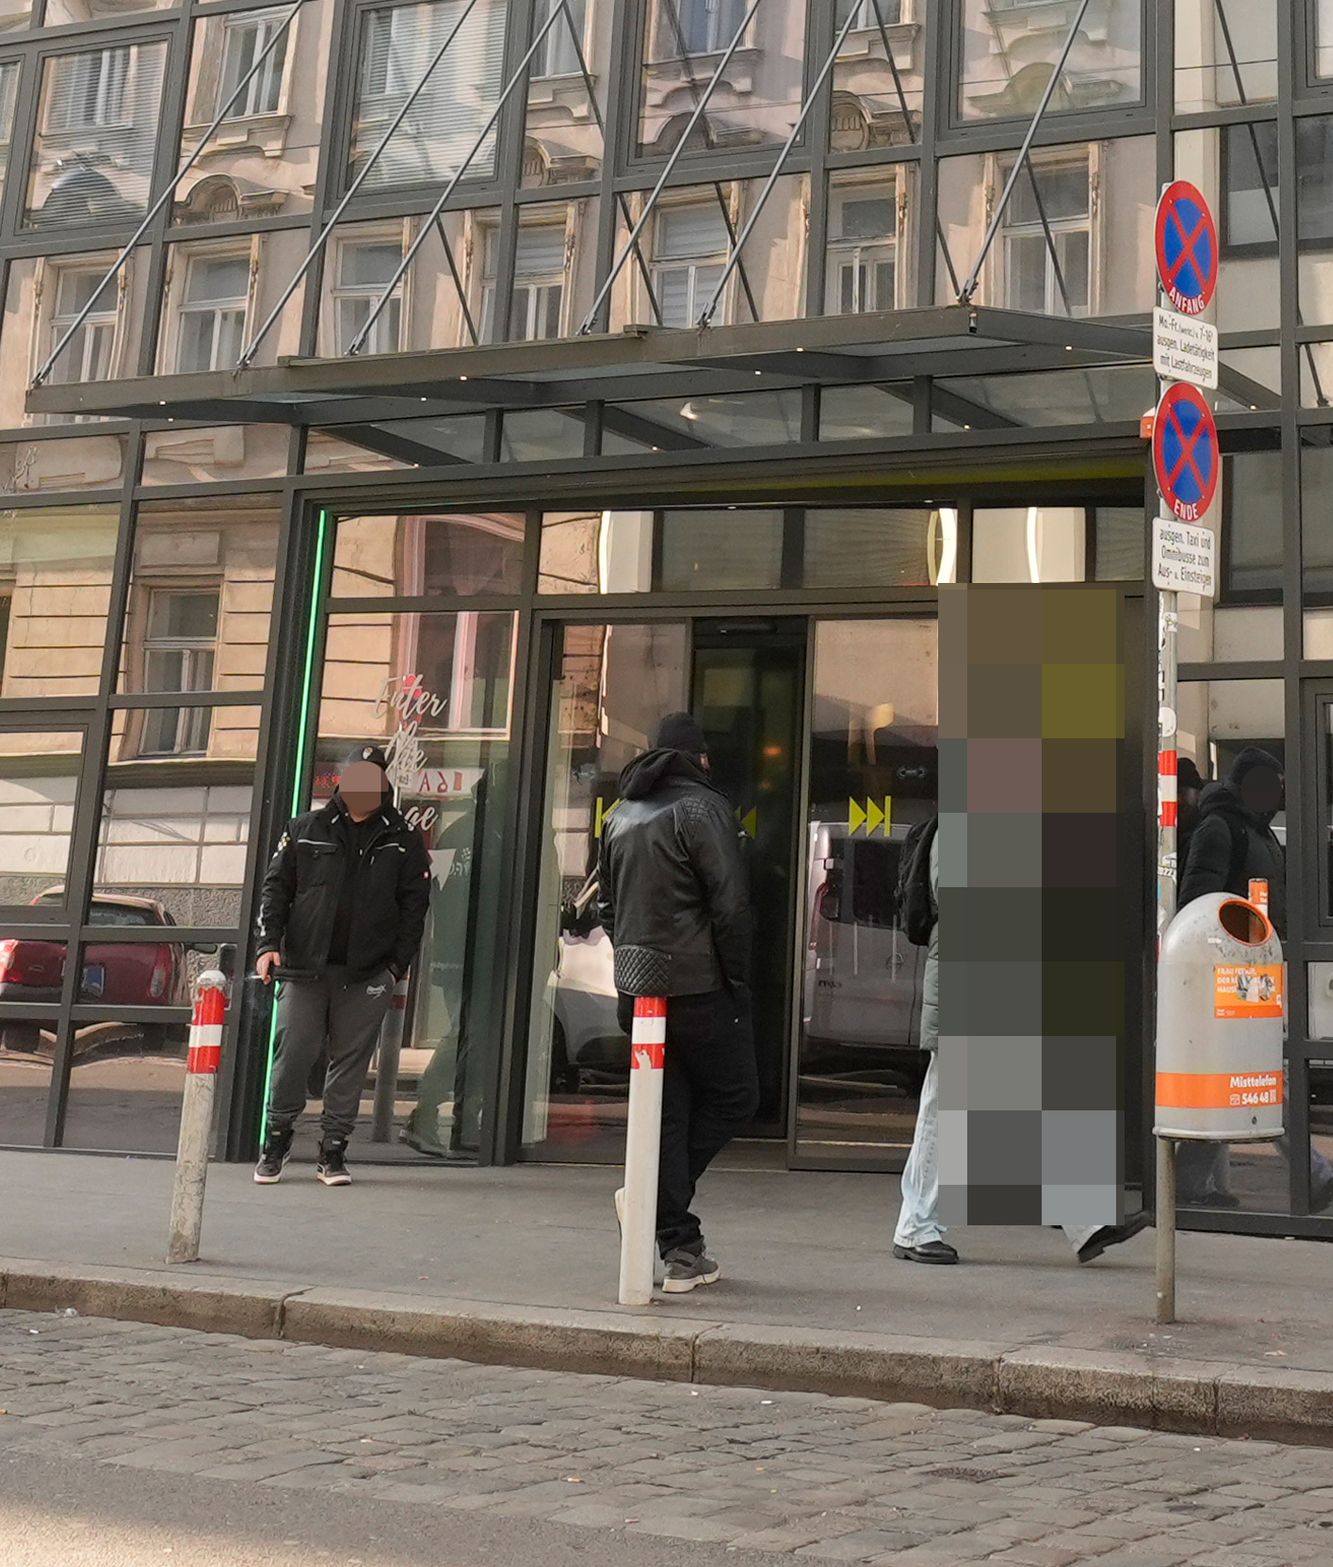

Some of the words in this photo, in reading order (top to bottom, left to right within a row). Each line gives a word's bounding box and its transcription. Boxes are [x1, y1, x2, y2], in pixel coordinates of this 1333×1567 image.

[1169, 286, 1206, 314] ANFANG
[1174, 499, 1199, 521] ENDE
[1186, 531, 1199, 546] Taxi
[1200, 536, 1211, 550] und
[1197, 554, 1210, 568] zum
[1158, 563, 1173, 579] Aus-
[1180, 566, 1212, 591] Einsteigen
[370, 674, 448, 720] Enter
[1230, 1074, 1277, 1088] Misttelefon
[1241, 1092, 1259, 1104] 546
[1260, 1091, 1269, 1103] 48
